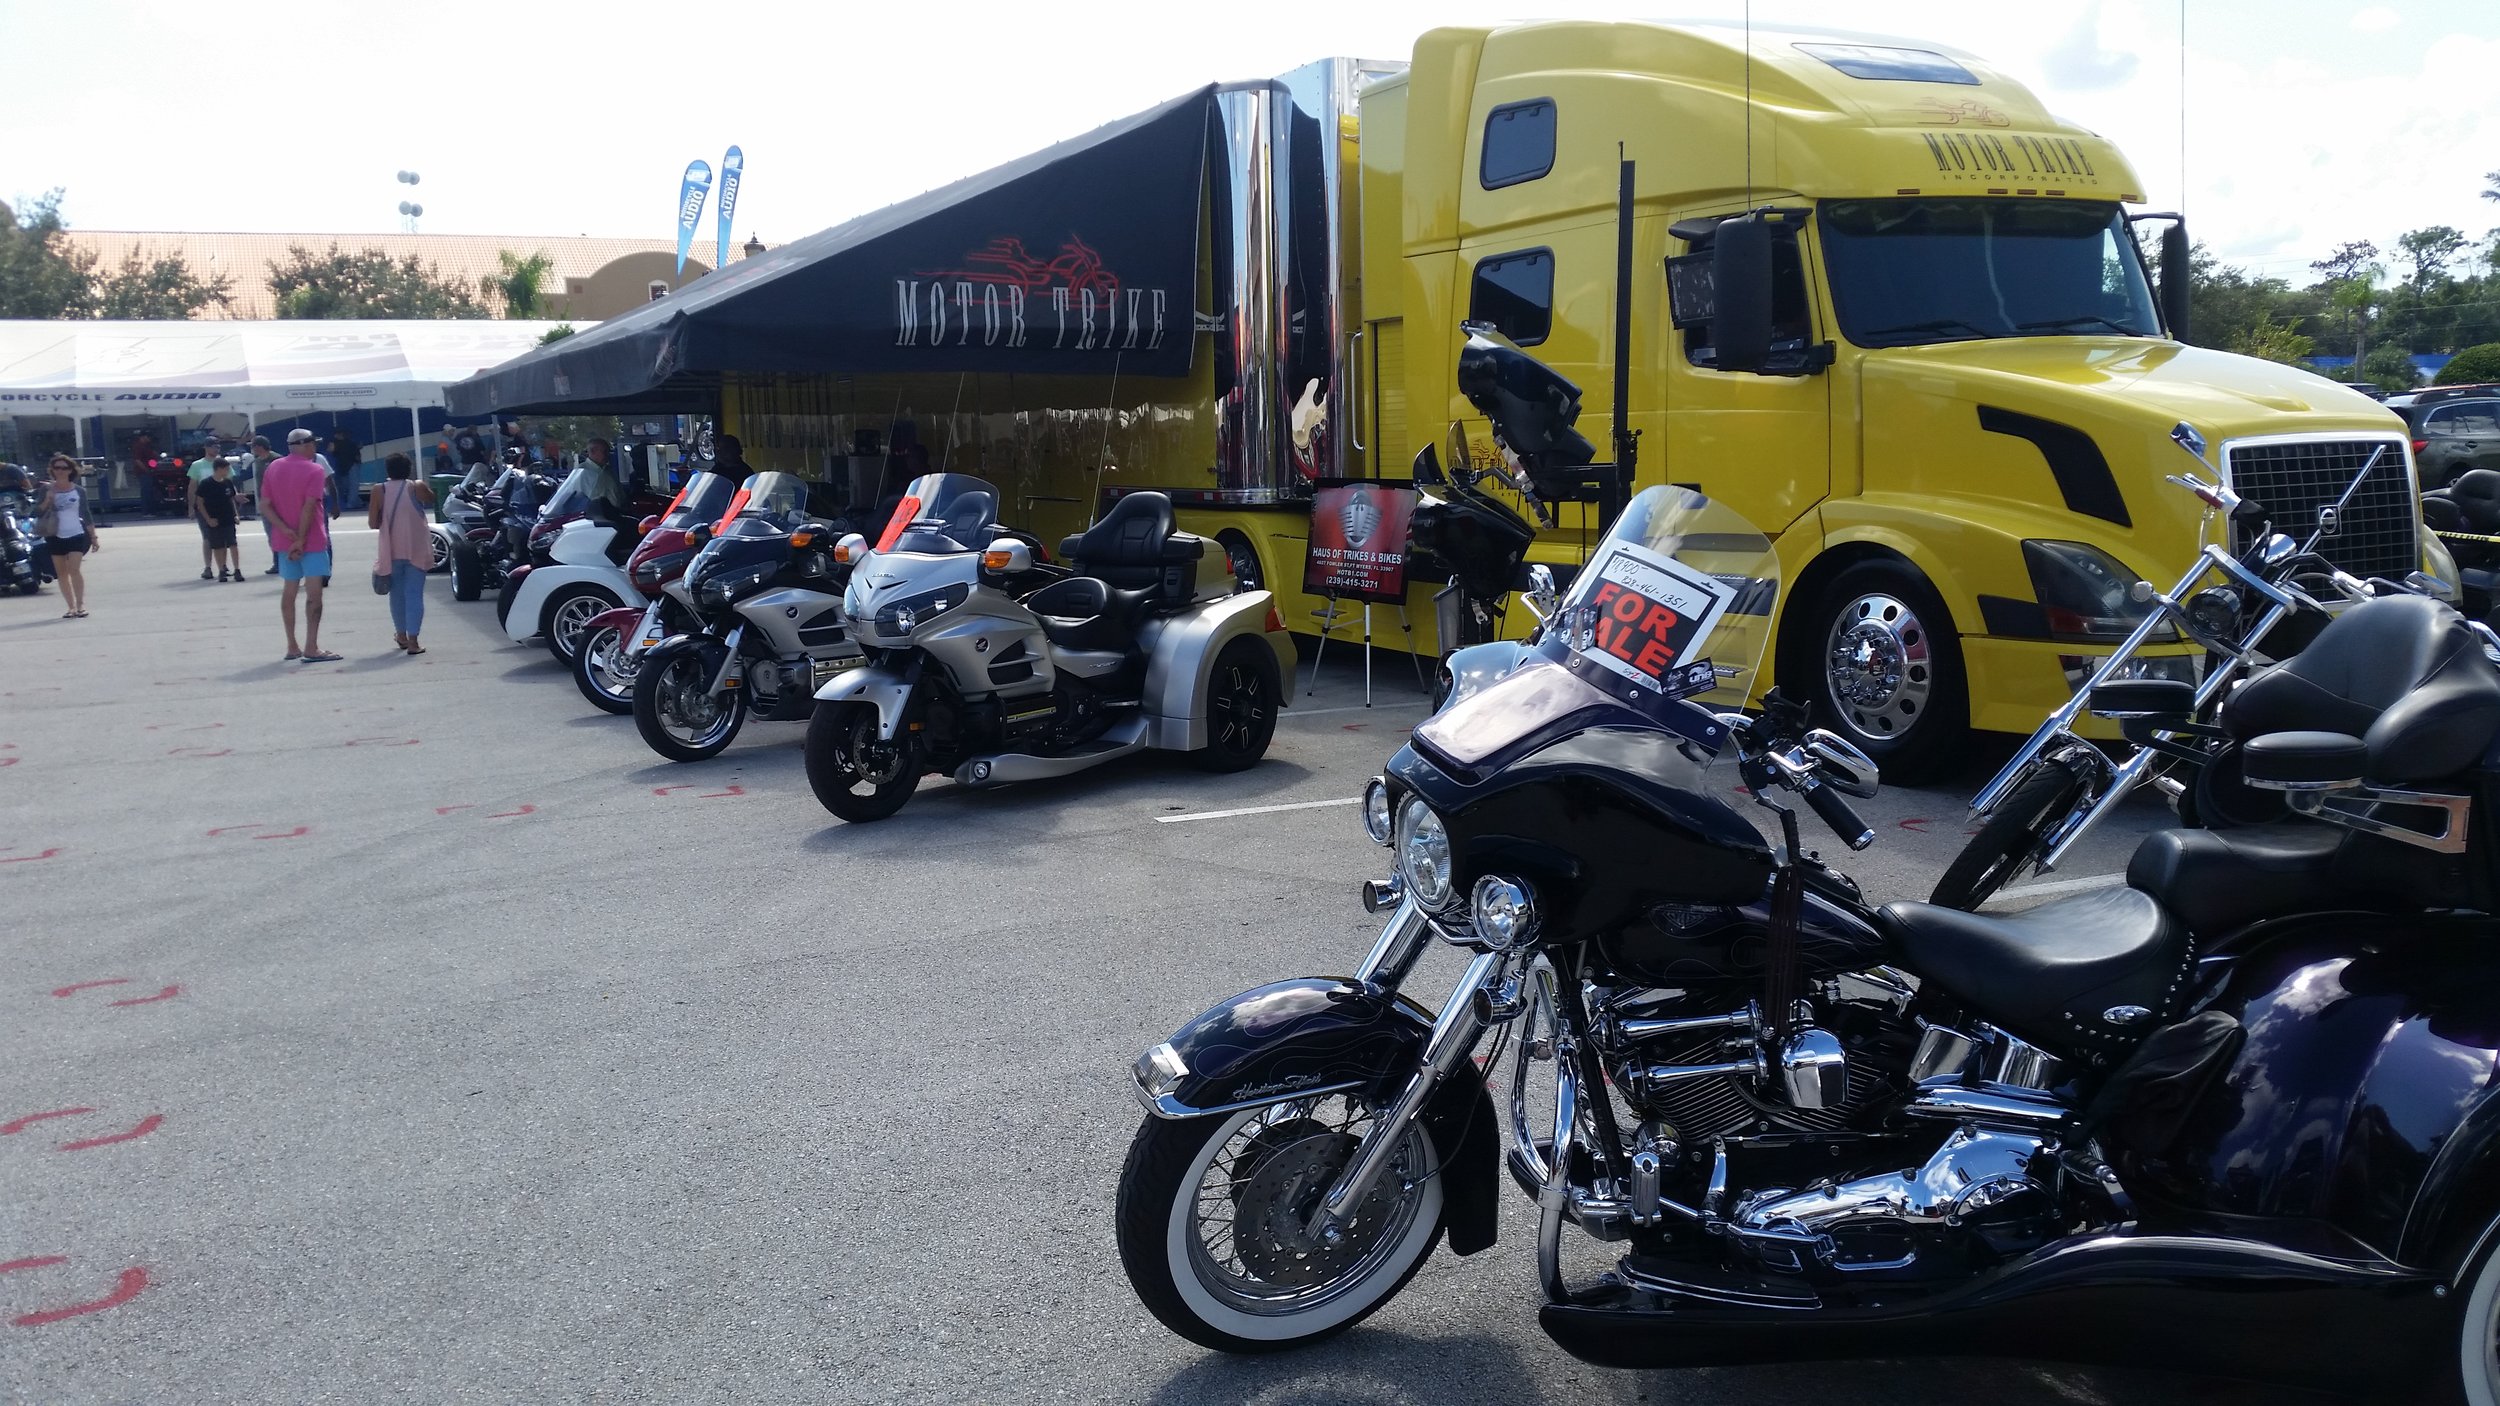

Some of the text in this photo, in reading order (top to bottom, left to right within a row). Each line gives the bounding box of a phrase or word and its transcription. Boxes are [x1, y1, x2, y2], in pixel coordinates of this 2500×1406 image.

[1921, 132, 2095, 176] MOTOR TRIKE
[722, 177, 738, 220] AUDIO
[1941, 173, 2098, 185] INCORPORATED
[682, 190, 705, 230] AUDIO
[895, 279, 1166, 350] MOTOR TRIKE
[114, 391, 222, 401] AUDIO
[1312, 547, 1402, 565] HAUS OF TRIKES & BIKES
[1326, 576, 1378, 589] (239)-415-3271
[1594, 581, 1679, 643] FOR
[1596, 616, 1675, 678] ALE
